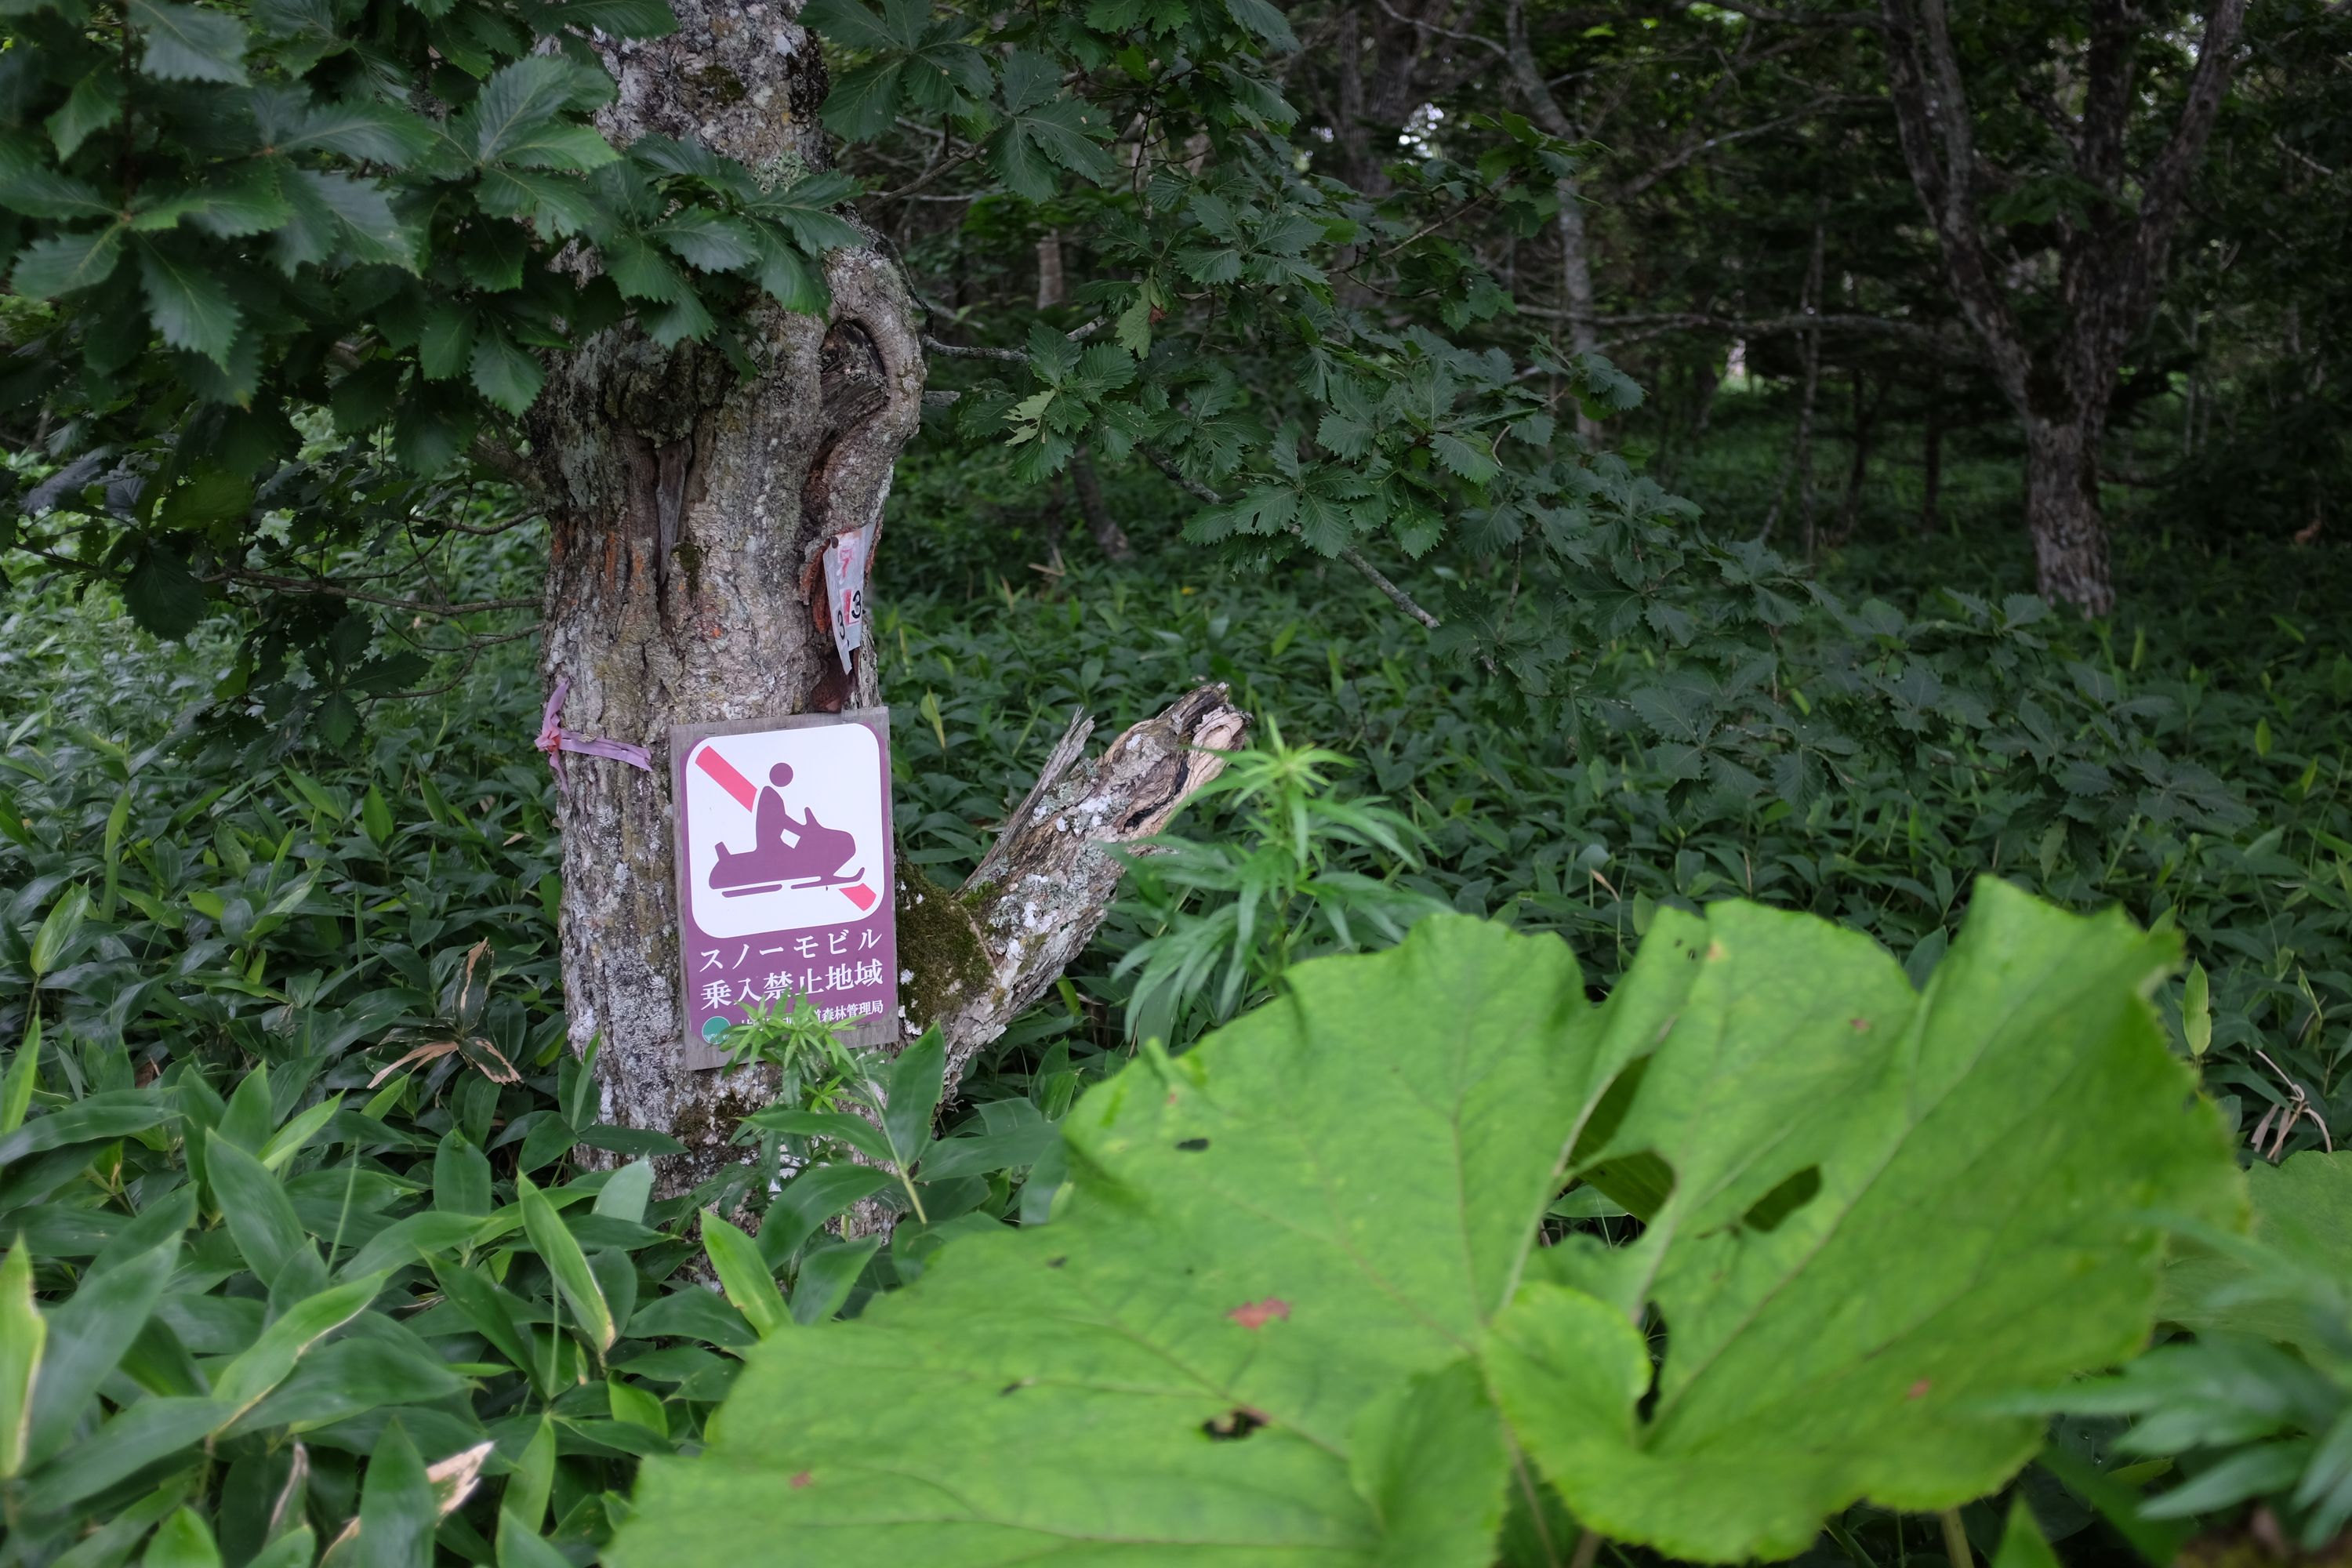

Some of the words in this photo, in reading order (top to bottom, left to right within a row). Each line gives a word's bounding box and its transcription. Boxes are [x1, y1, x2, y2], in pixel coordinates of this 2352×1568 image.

[700, 929, 883, 972] スノーモビル
[700, 958, 884, 1011] 乗入禁止地域
